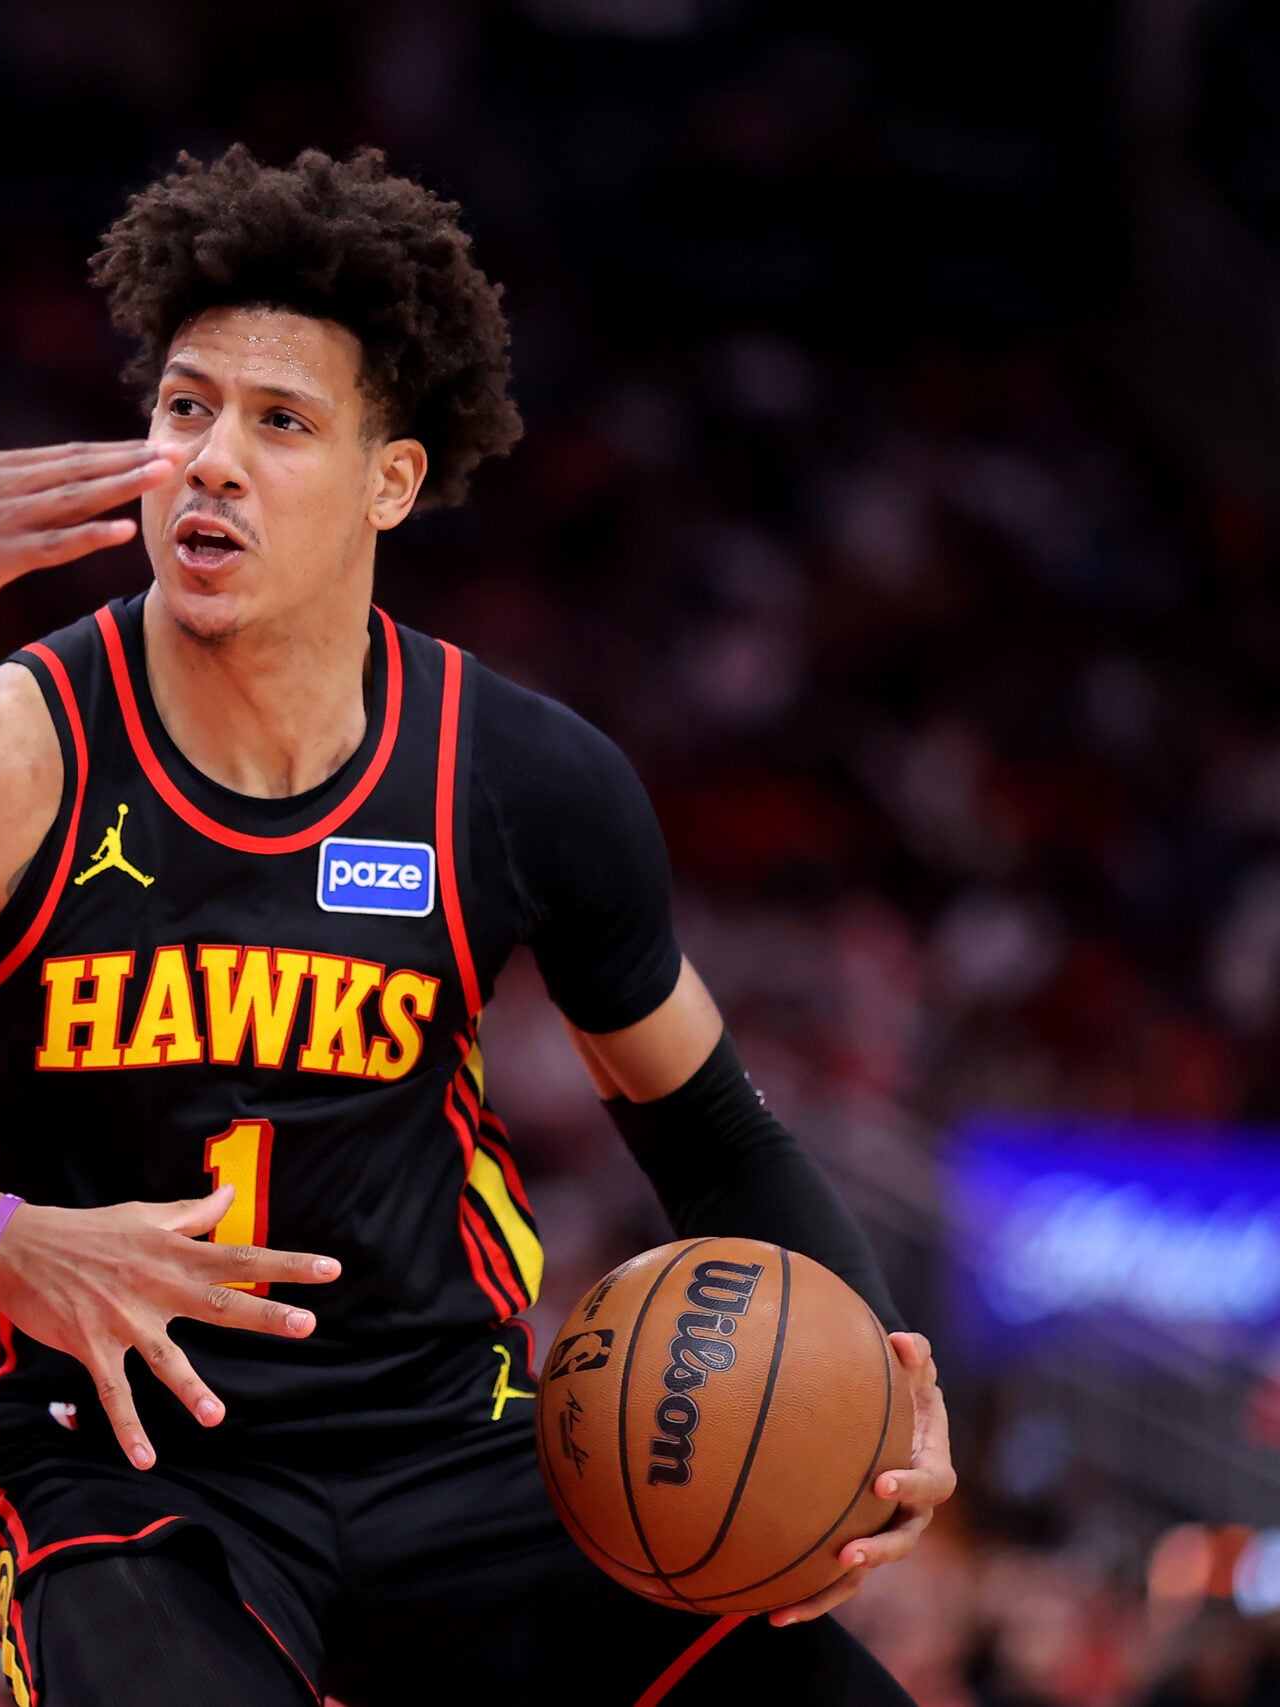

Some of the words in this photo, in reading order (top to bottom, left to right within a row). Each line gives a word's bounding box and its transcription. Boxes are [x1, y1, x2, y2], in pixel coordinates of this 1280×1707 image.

[328, 859, 423, 893] paze
[34, 943, 441, 1083] HAWKS
[203, 1118, 275, 1297] 1
[646, 1259, 765, 1487] Wilson
